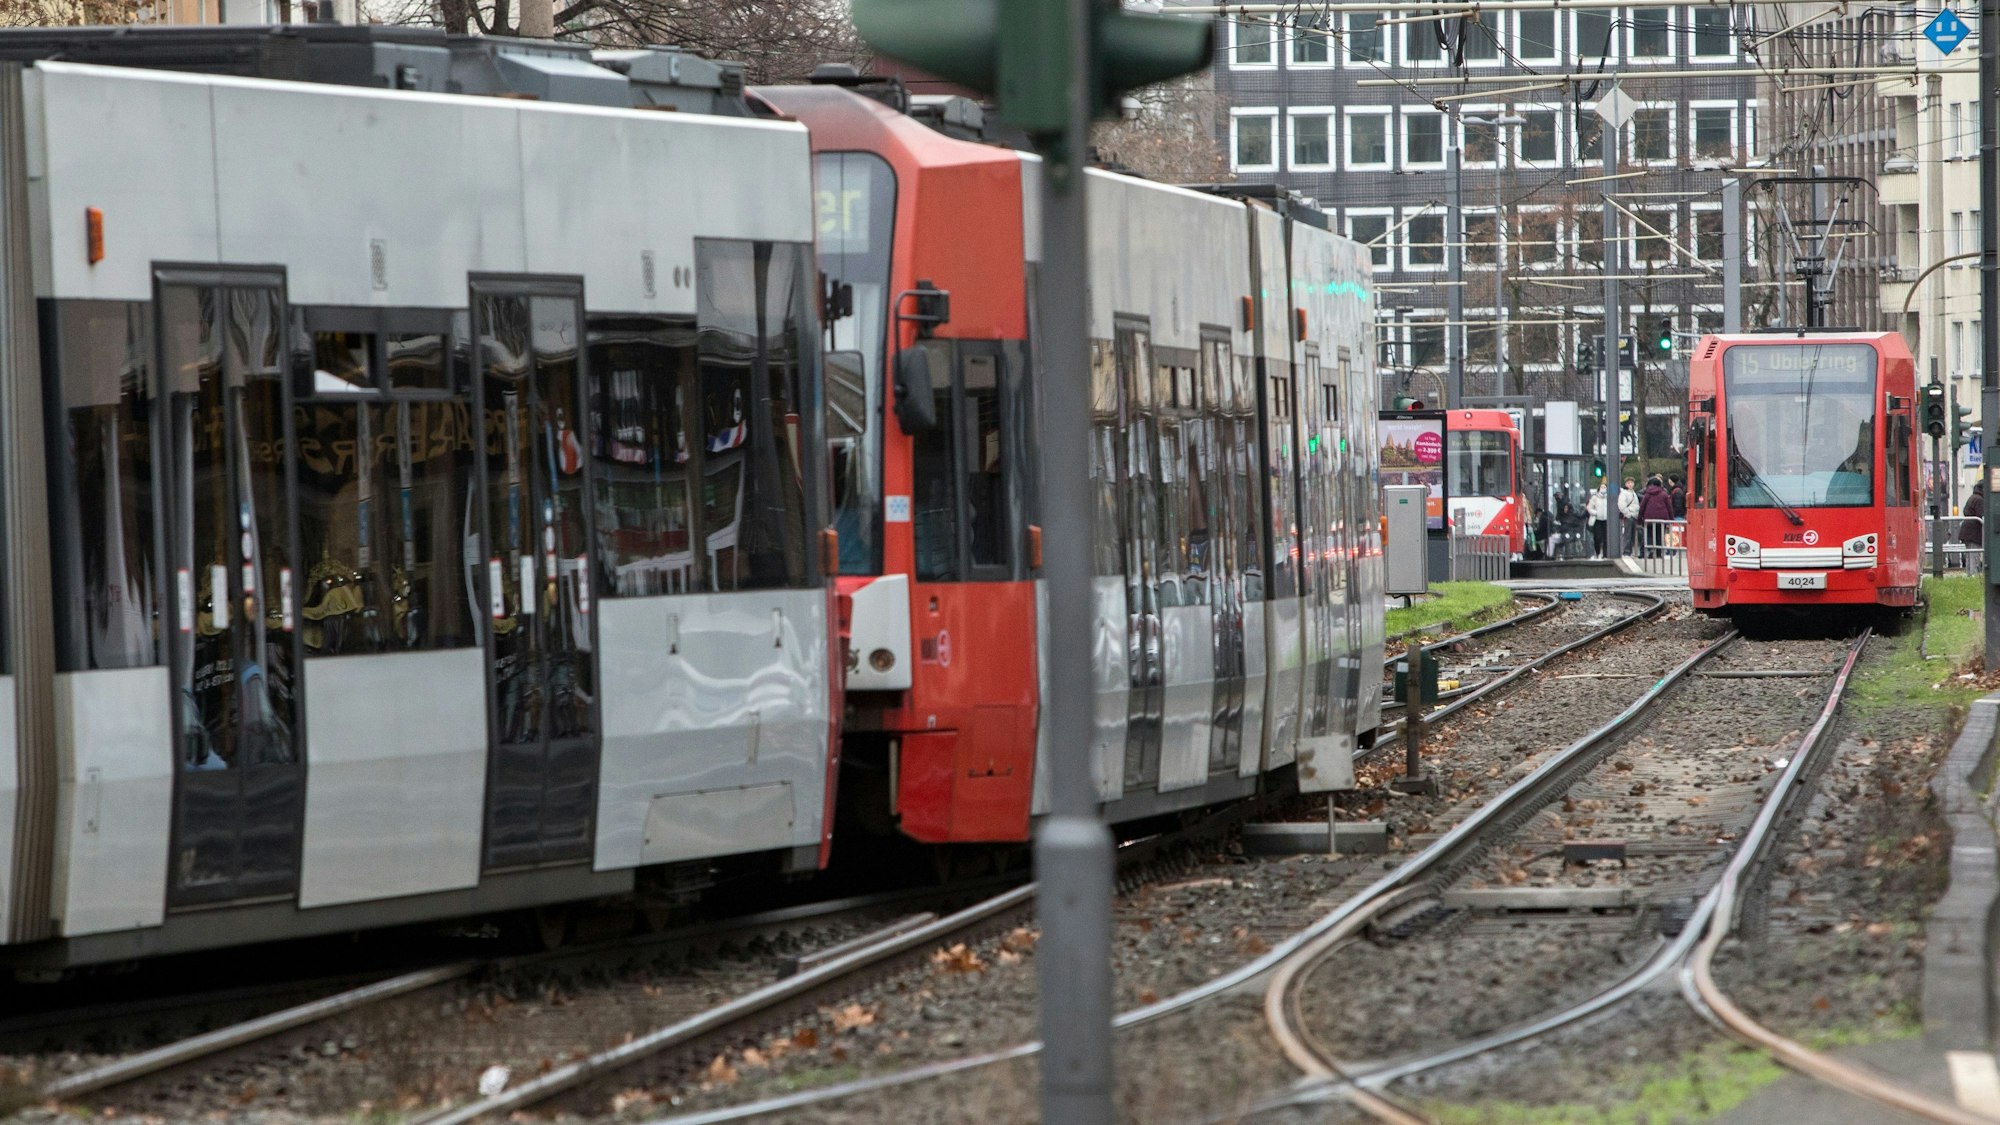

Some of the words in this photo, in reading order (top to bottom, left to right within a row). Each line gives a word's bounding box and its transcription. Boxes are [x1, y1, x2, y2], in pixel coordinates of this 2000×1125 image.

[1740, 353, 1760, 375] 15
[1770, 353, 1858, 373] Ubierring
[1788, 577, 1815, 586] 4024
